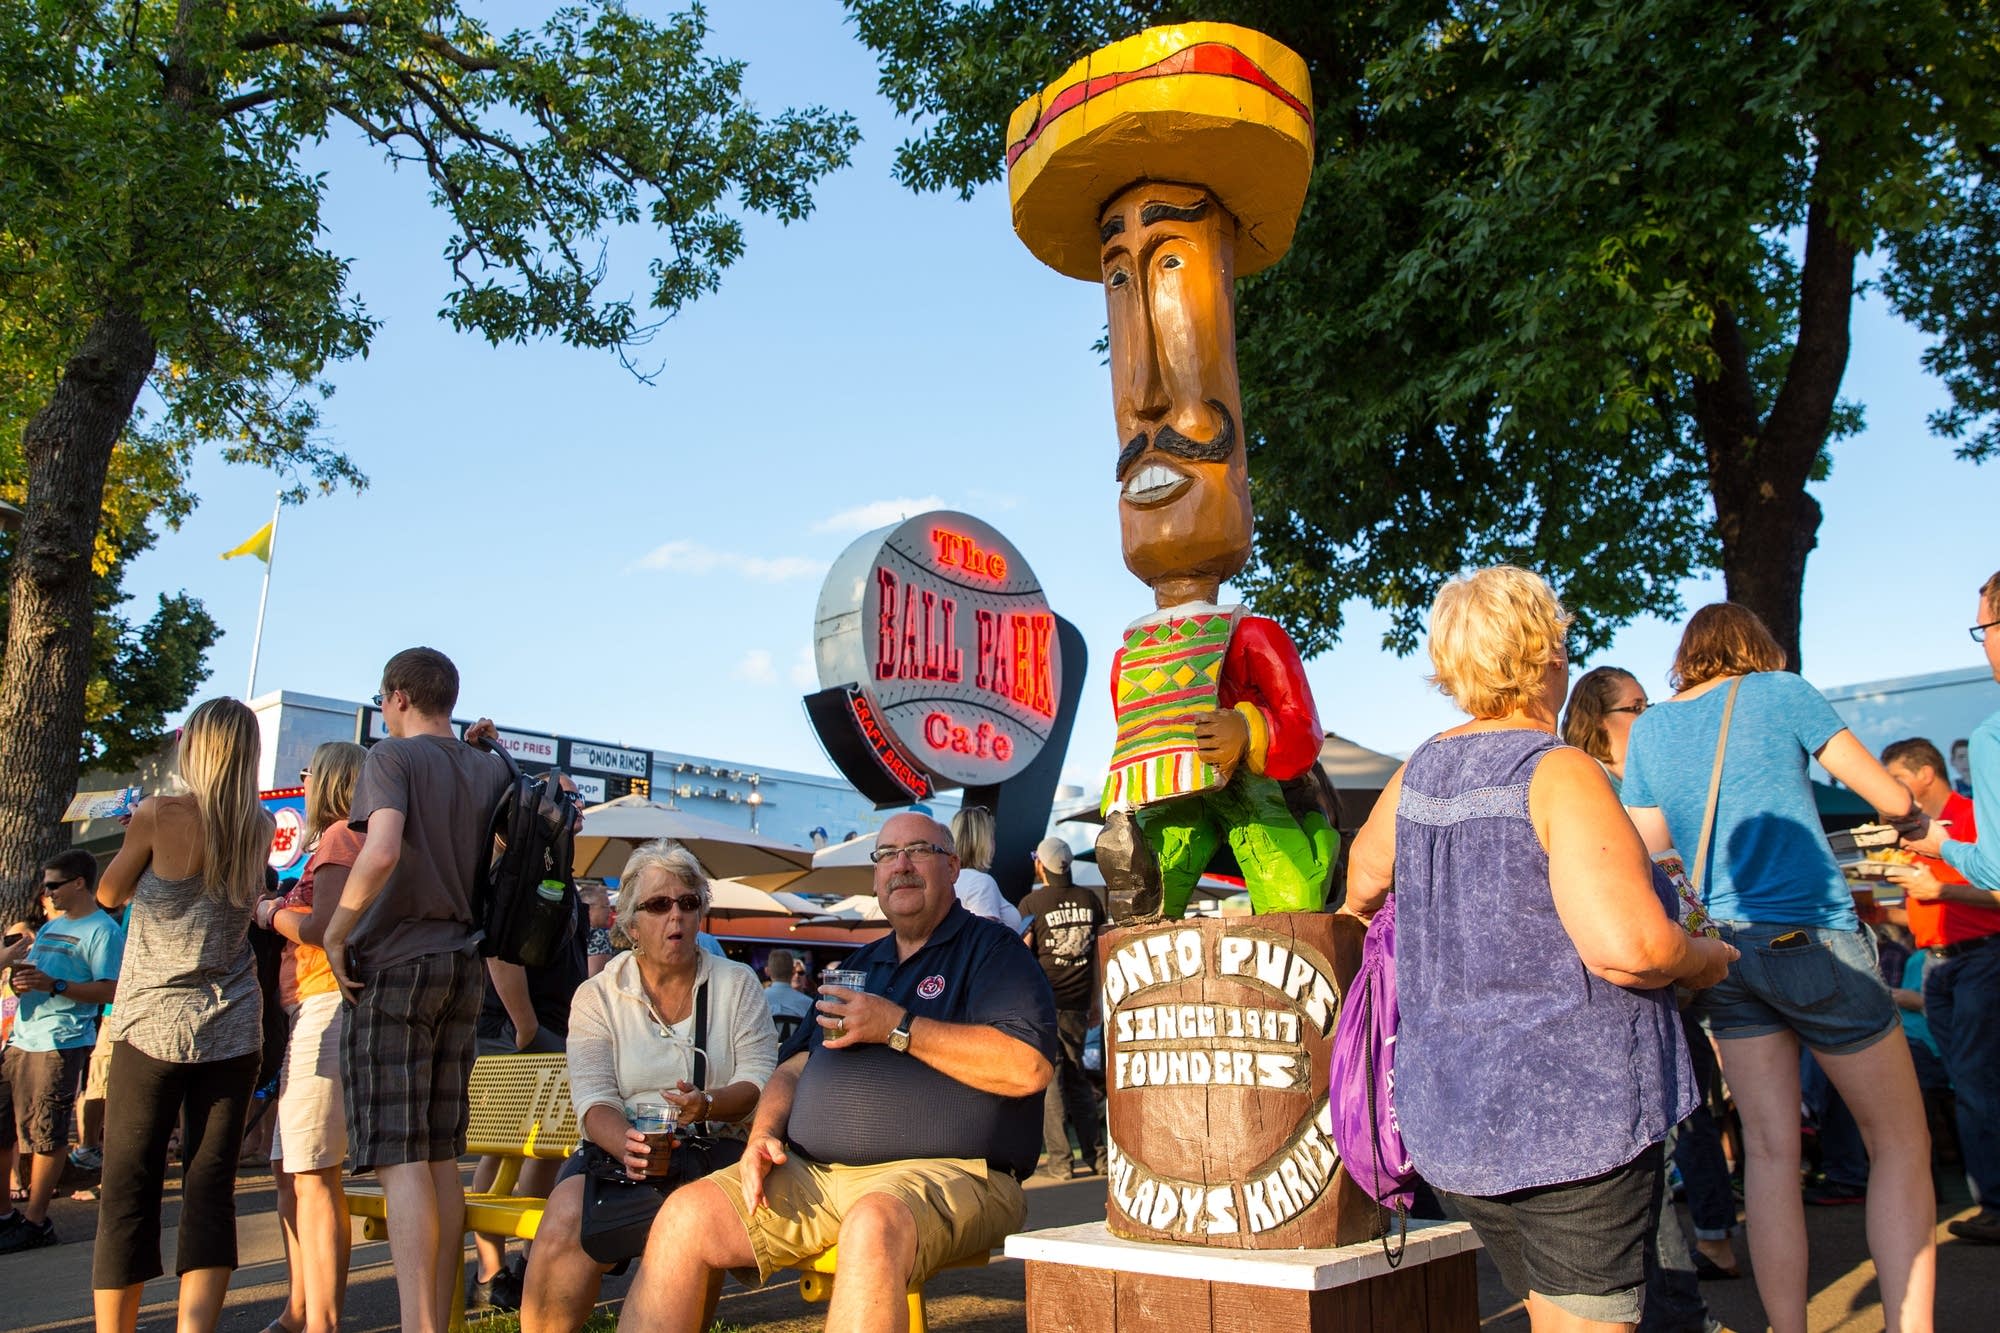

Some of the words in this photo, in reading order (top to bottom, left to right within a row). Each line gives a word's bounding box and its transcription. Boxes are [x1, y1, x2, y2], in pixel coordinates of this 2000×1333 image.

[933, 528, 1007, 579] The
[876, 567, 964, 683] BALL
[976, 609, 1056, 718] PARK
[523, 742, 552, 756] FRIES
[854, 697, 887, 750] CRAFT
[883, 749, 927, 797] BREWS
[925, 712, 1014, 762] Cafe
[589, 749, 618, 768] ONION
[620, 754, 646, 772] RINGS
[578, 784, 598, 794] POP
[1221, 937, 1338, 1034] PUPS
[1116, 1004, 1216, 1042] SINCE
[1115, 1051, 1297, 1090] FOUNDERS
